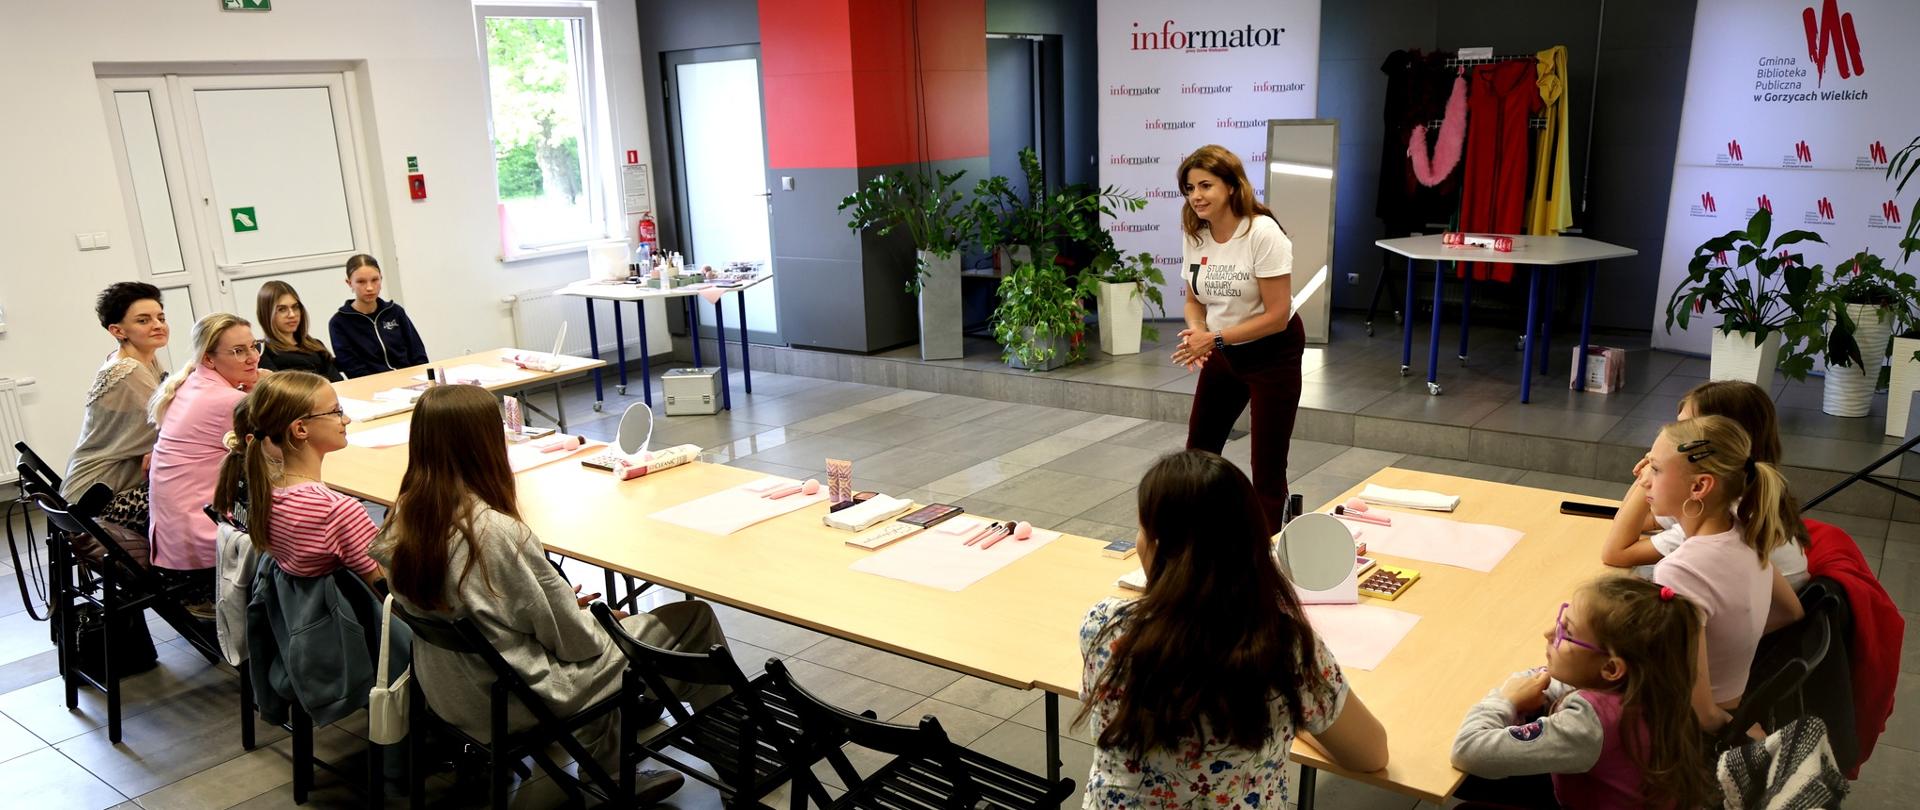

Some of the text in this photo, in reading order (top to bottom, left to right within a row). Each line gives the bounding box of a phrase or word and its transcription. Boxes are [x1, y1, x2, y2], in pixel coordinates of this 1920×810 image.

[1131, 20, 1285, 50] informator
[1758, 56, 1796, 67] Gminna
[1756, 67, 1807, 79] Biblioteka
[1110, 84, 1161, 96] informator
[1181, 83, 1232, 94] informator
[1253, 81, 1305, 92] informator
[1755, 80, 1802, 91] Publiczna
[1753, 89, 1868, 104] w Gorzycach Wielkich
[1145, 119, 1196, 130] informator
[1216, 117, 1267, 128] informator
[1111, 154, 1160, 165] informator
[1144, 187, 1183, 198] informa
[1111, 221, 1160, 232] informator
[1206, 264, 1236, 273] STUDIUM
[1205, 271, 1250, 281] ANIMATORÓW
[1204, 281, 1232, 290] KULTURY
[1206, 288, 1242, 297] W KALISZU
